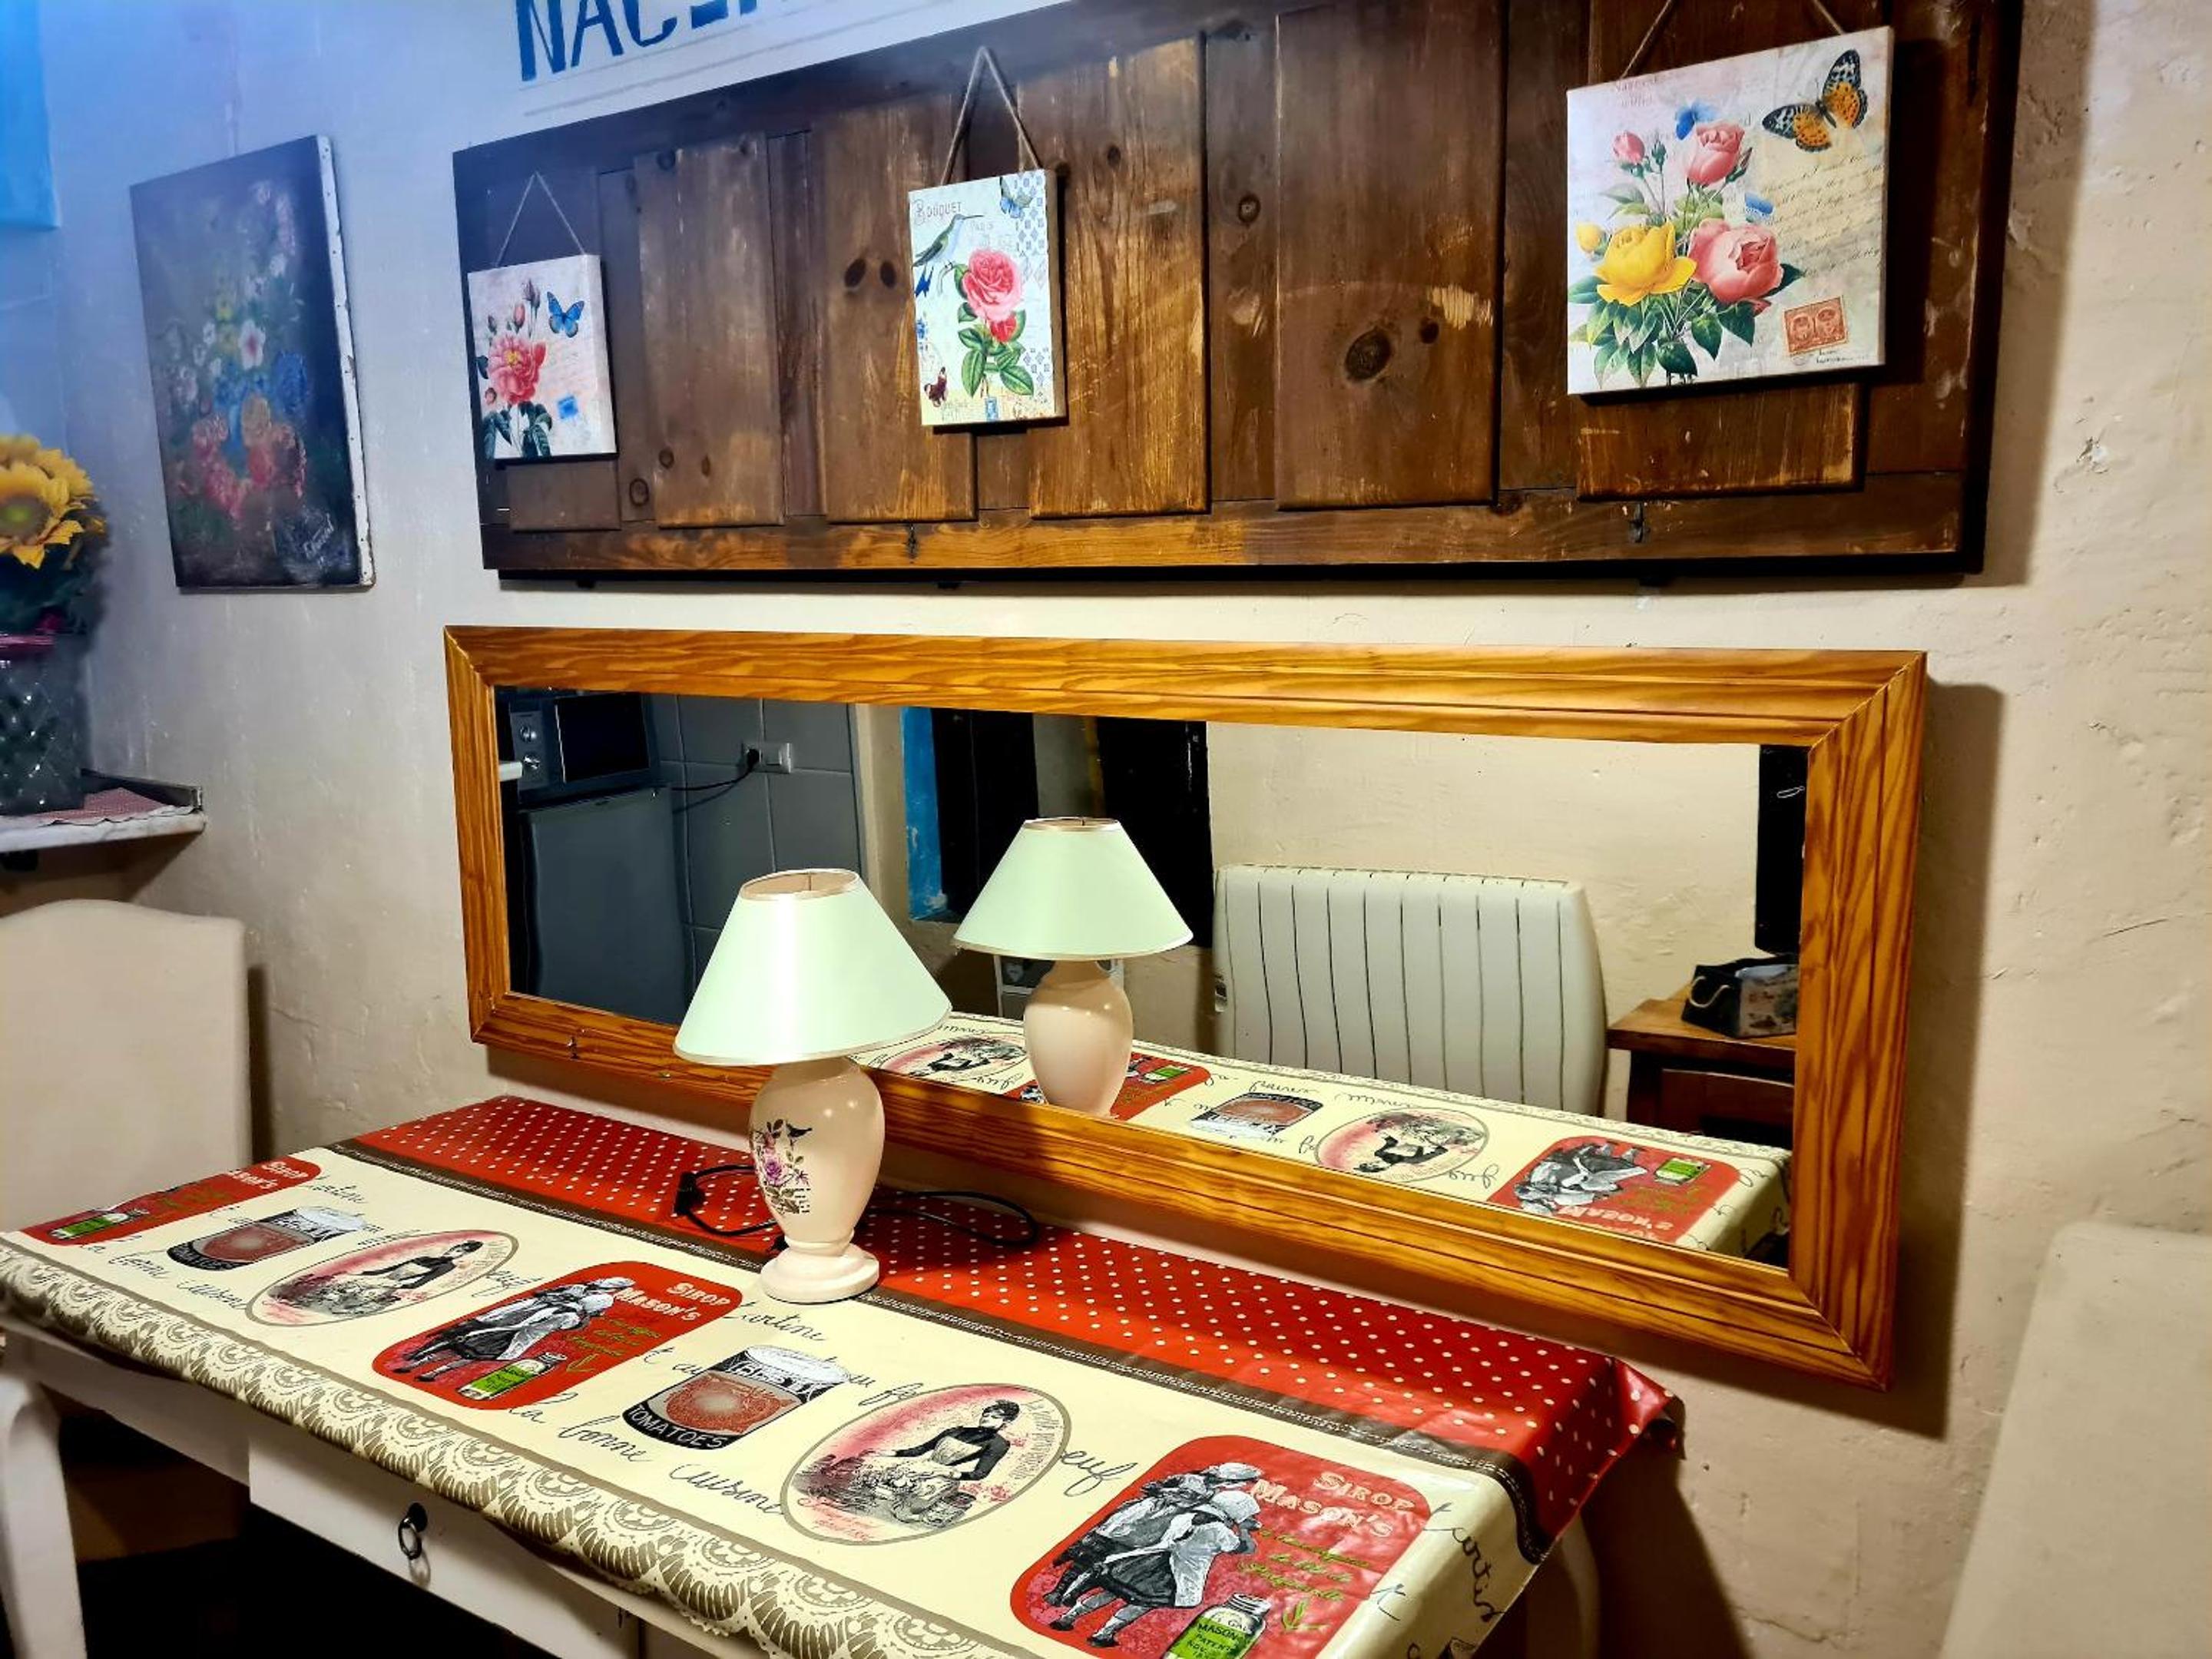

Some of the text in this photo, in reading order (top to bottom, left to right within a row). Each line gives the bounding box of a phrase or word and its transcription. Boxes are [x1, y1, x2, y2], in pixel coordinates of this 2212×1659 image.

[516, 0, 757, 81] NAC
[614, 1286, 701, 1321] MASON'S
[667, 1282, 730, 1306] SIROP
[627, 1404, 728, 1449] TOMATOES
[1250, 1478, 1393, 1538] MASON'S
[1312, 1471, 1416, 1512] SIROP
